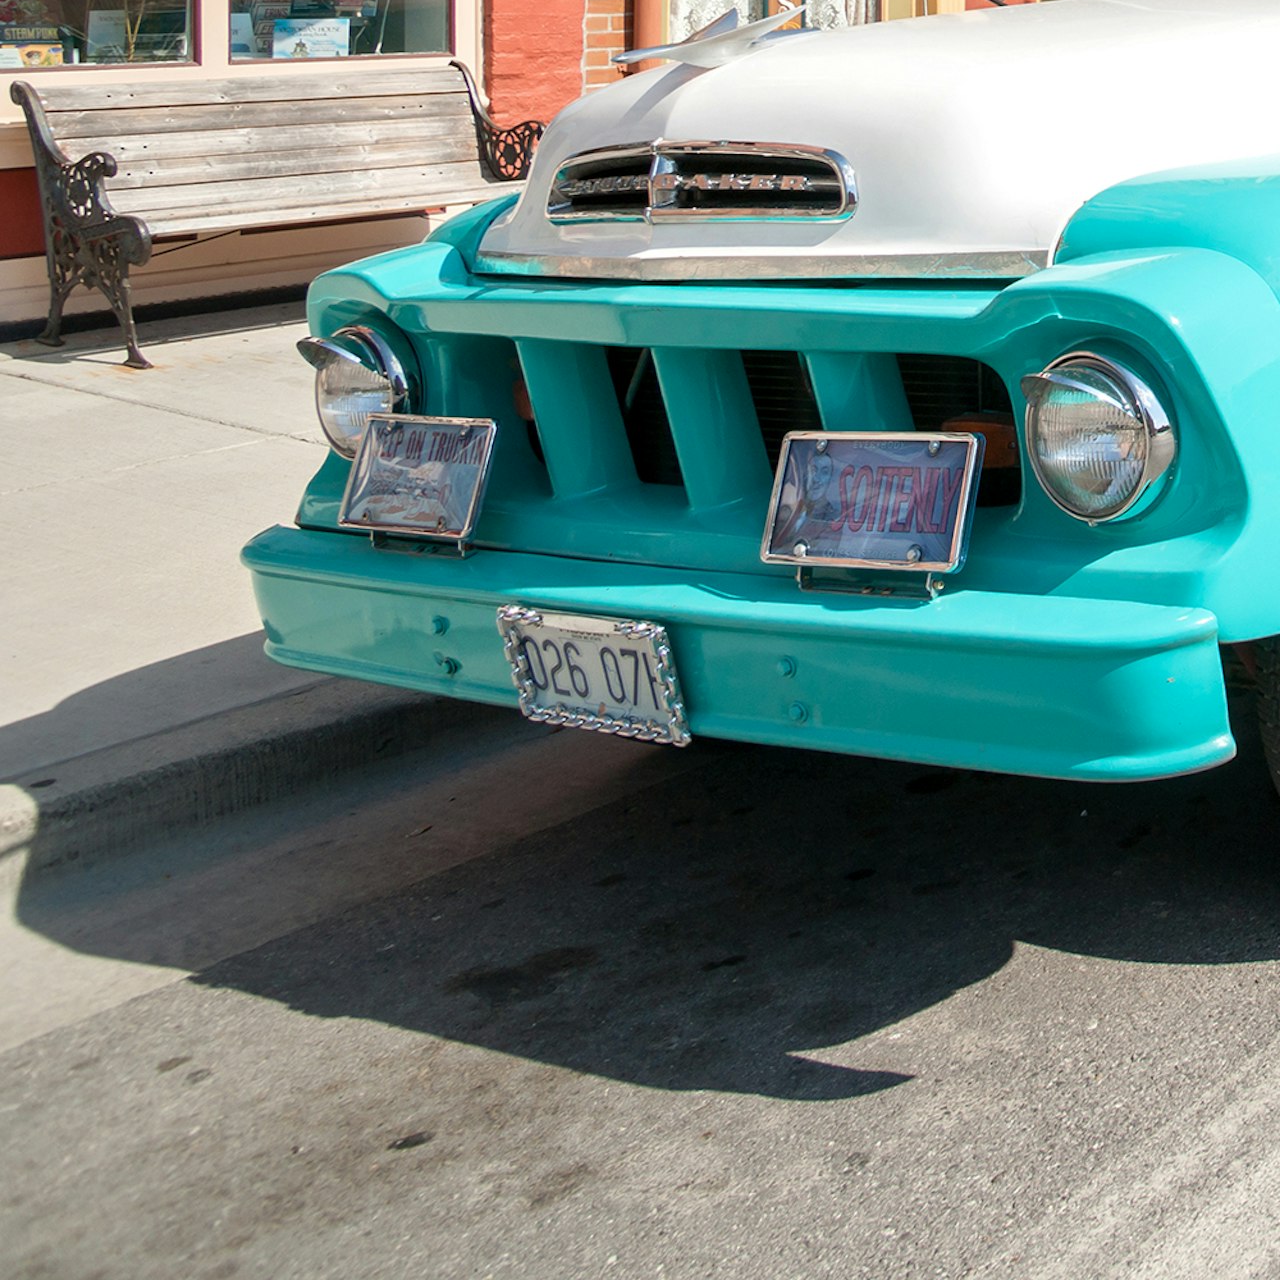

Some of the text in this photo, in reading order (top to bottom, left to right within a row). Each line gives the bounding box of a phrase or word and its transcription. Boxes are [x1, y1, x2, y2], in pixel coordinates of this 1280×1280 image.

[4, 27, 59, 40] STEAMPUNK
[376, 427, 488, 464] KEEP ON TRUCKIN
[831, 464, 964, 534] SOITENLY
[522, 635, 589, 698] 026
